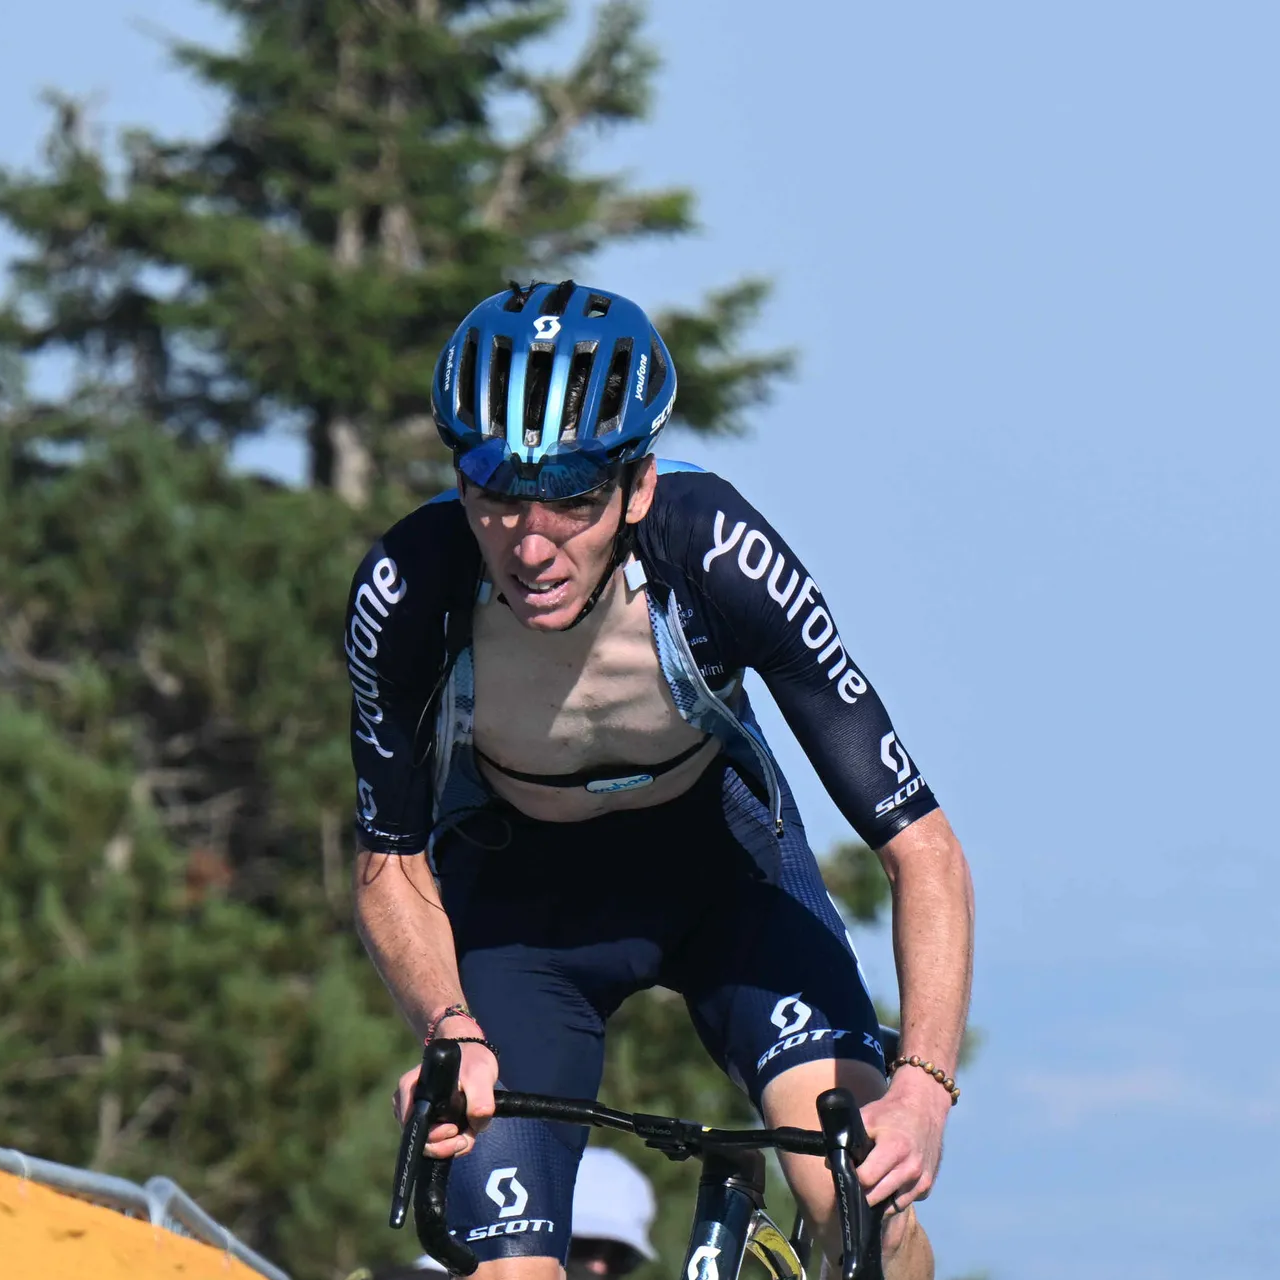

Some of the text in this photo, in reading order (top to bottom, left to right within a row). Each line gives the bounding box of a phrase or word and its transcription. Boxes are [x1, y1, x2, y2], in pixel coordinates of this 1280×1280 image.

[635, 353, 647, 400] youfone
[703, 510, 868, 704] youfone
[875, 773, 925, 818] SCOT
[756, 1028, 852, 1076] SCOTT
[837, 1172, 852, 1252] DURA-ACE
